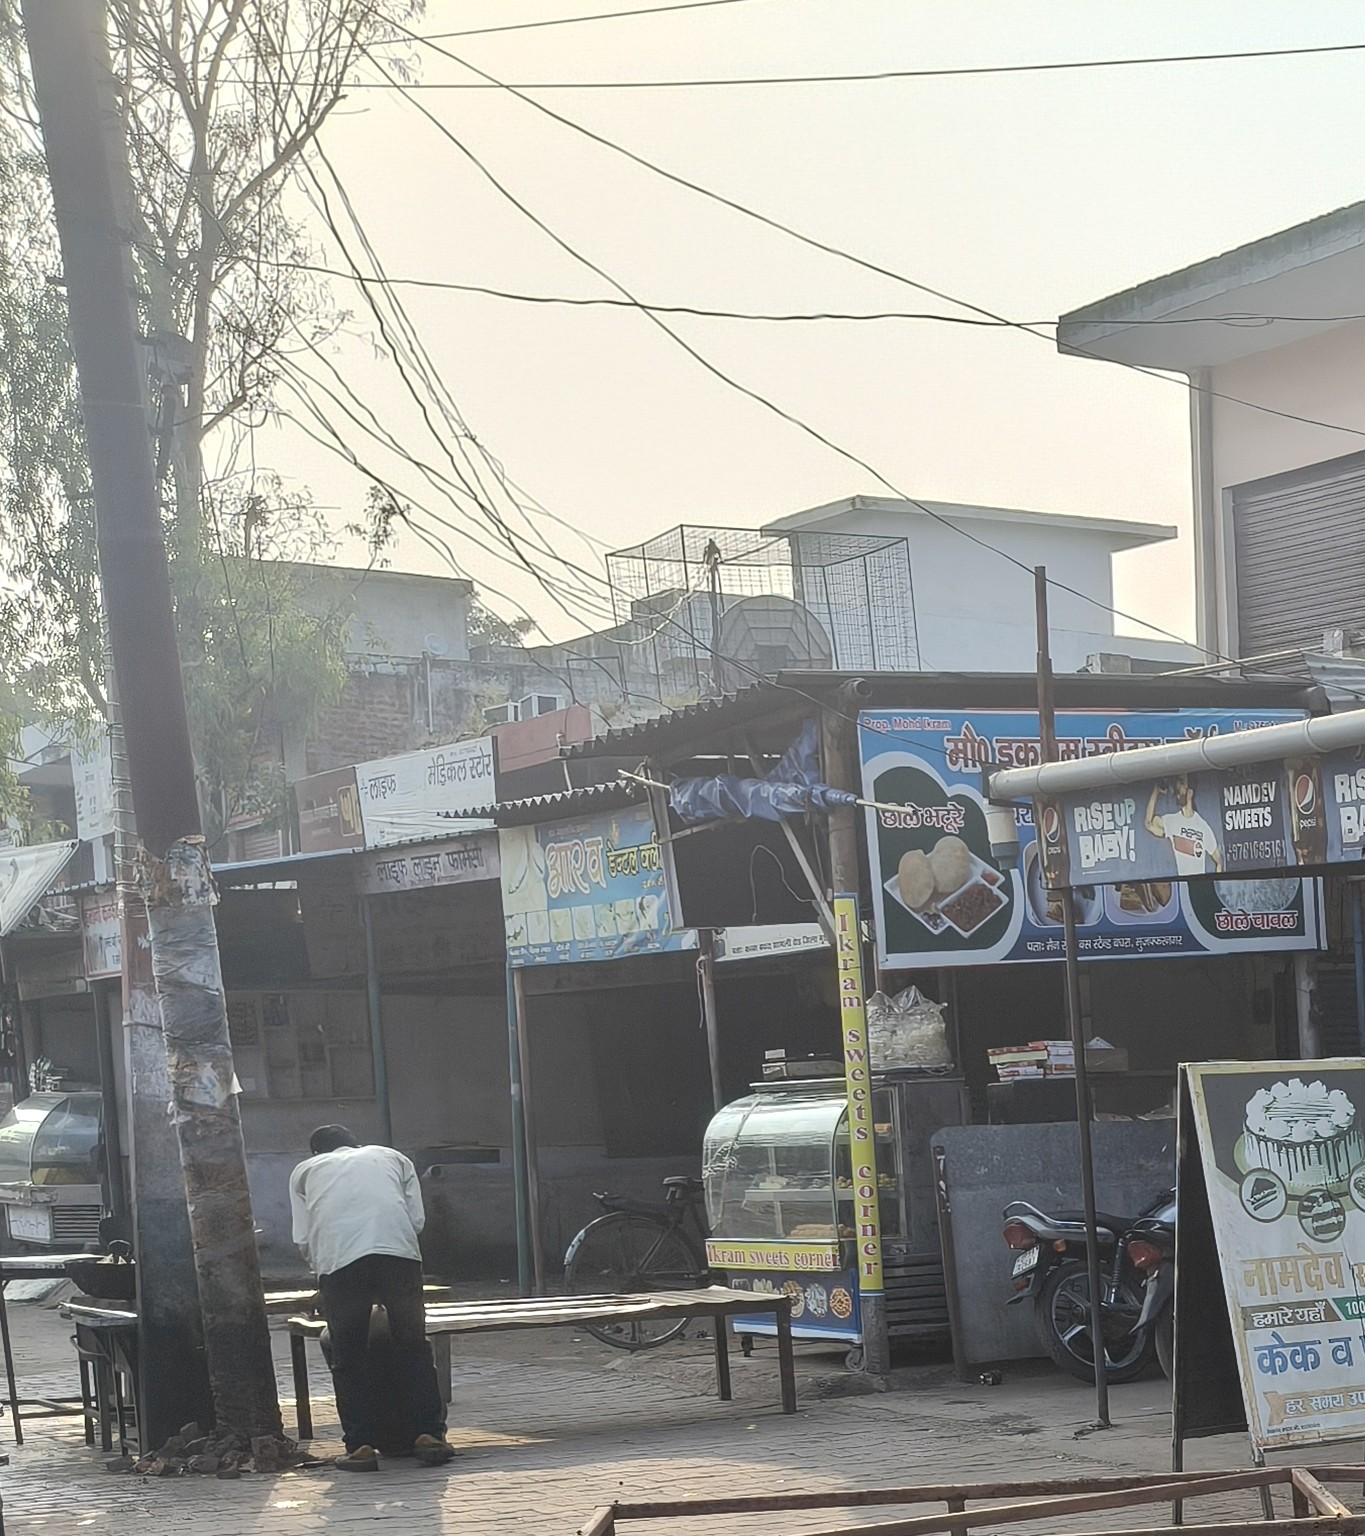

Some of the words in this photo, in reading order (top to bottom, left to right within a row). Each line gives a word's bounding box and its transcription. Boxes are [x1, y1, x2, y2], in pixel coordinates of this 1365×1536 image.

[893, 716, 921, 730] Mohd
[1223, 781, 1276, 806] NAMDEV
[1073, 801, 1116, 833] RISE
[1114, 798, 1136, 827] UP
[1225, 806, 1272, 831] SWEETS
[1079, 825, 1137, 869] BABY!
[845, 1026, 869, 1141] sweets
[856, 1163, 881, 1277] corner
[706, 1244, 746, 1264] Ikram
[749, 1249, 790, 1268] sweets
[1239, 1243, 1346, 1297] नामदेव
[1250, 1305, 1295, 1329] हमारे
[1294, 1301, 1327, 1323] यहाँ
[1253, 1331, 1322, 1376] केक
[1328, 1336, 1355, 1367] व
[1285, 1398, 1306, 1415] हर
[1308, 1393, 1345, 1411] समय
